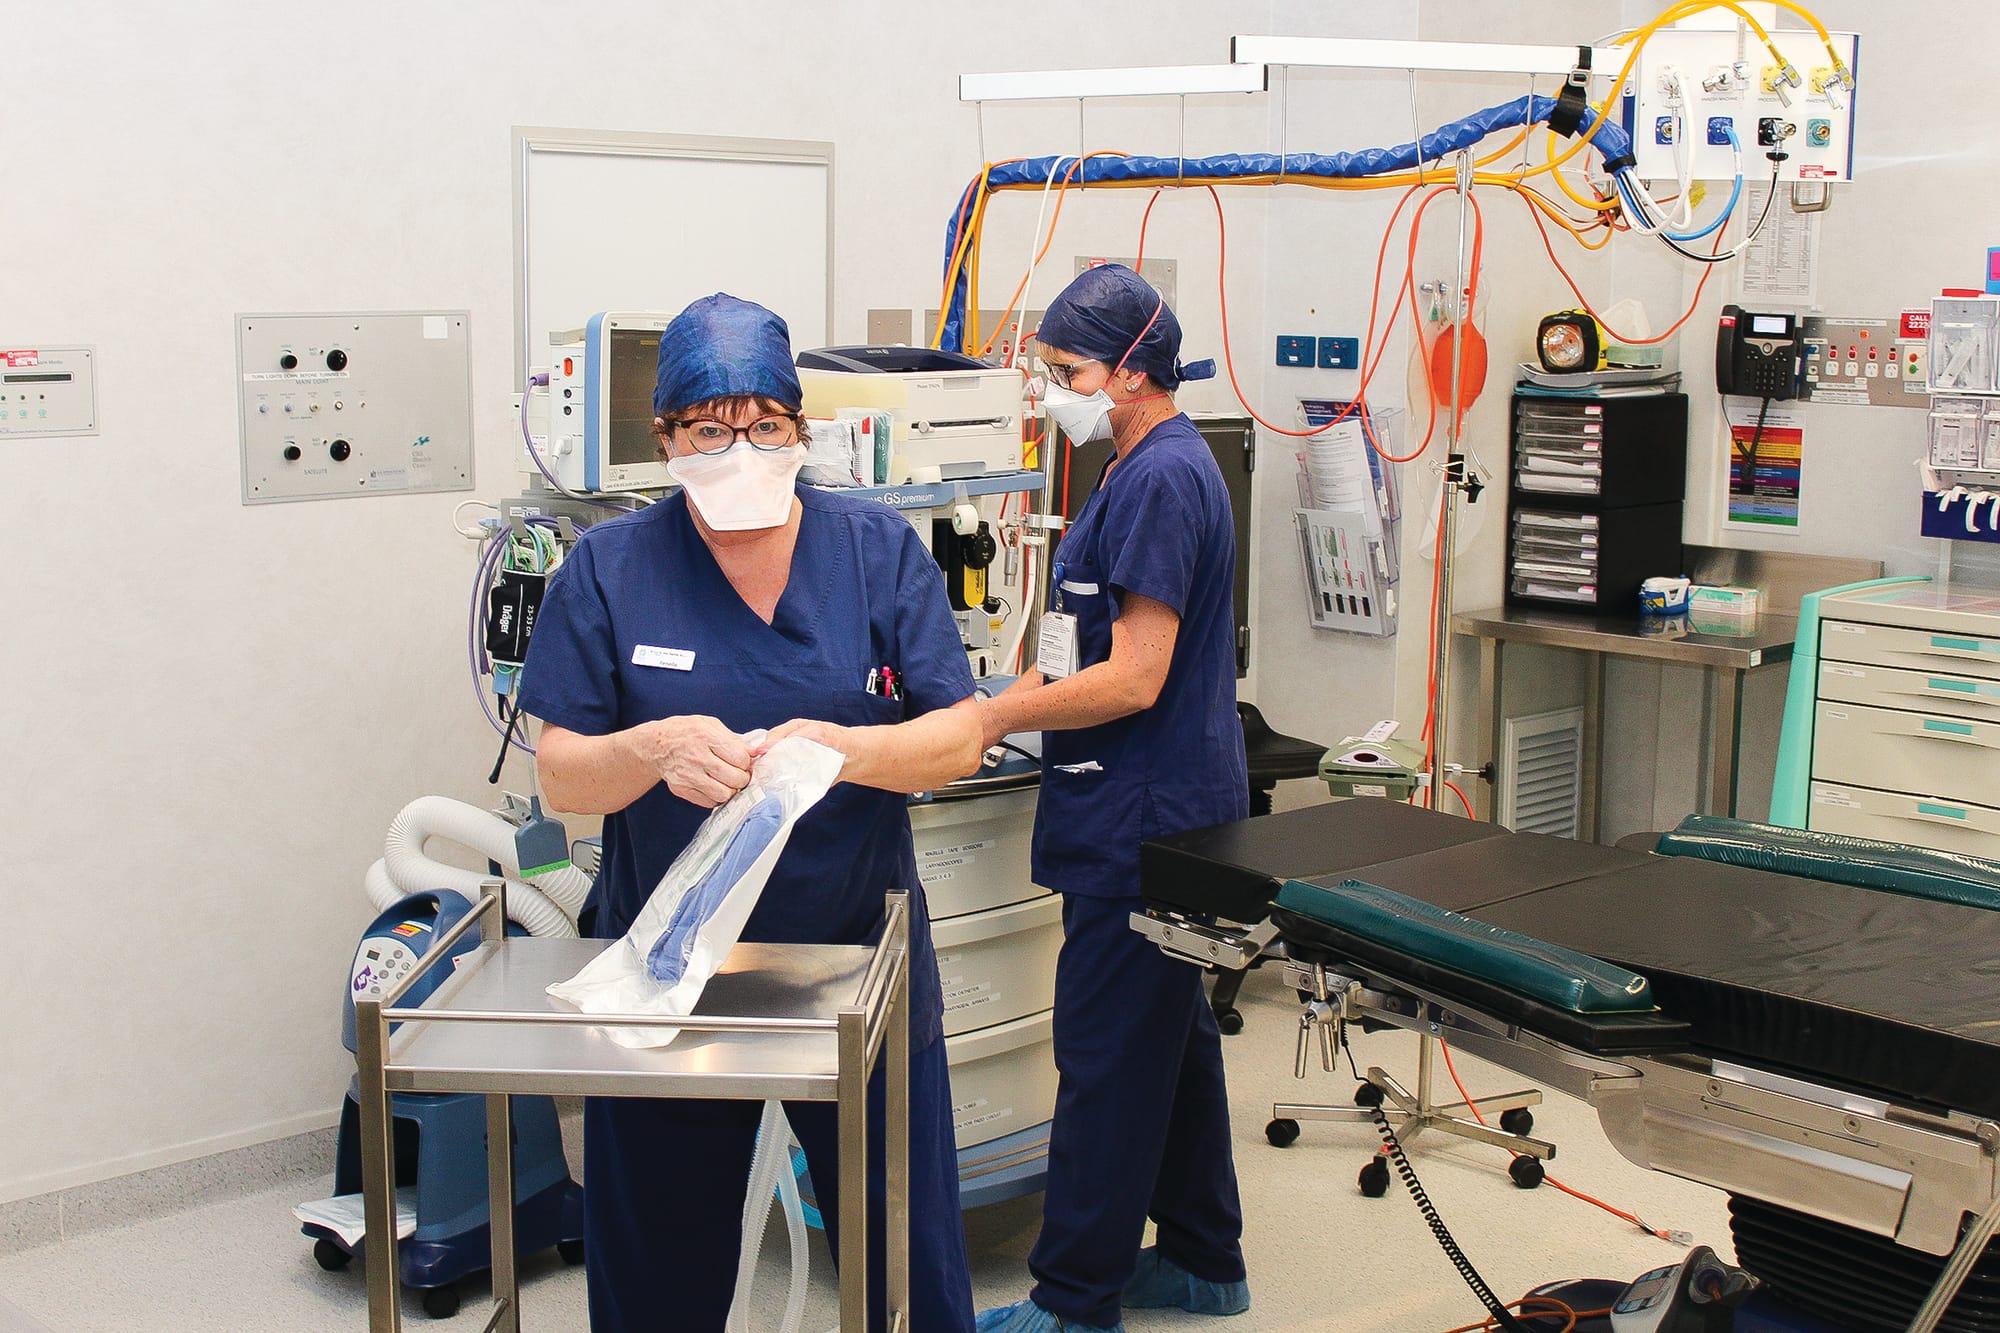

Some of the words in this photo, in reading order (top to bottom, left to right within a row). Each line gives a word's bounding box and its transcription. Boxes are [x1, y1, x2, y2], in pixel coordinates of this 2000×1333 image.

[883, 492, 900, 505] GS
[901, 494, 935, 505] premium
[500, 605, 513, 634] Dräger
[527, 605, 535, 624] 23-33
[526, 626, 532, 636] cm
